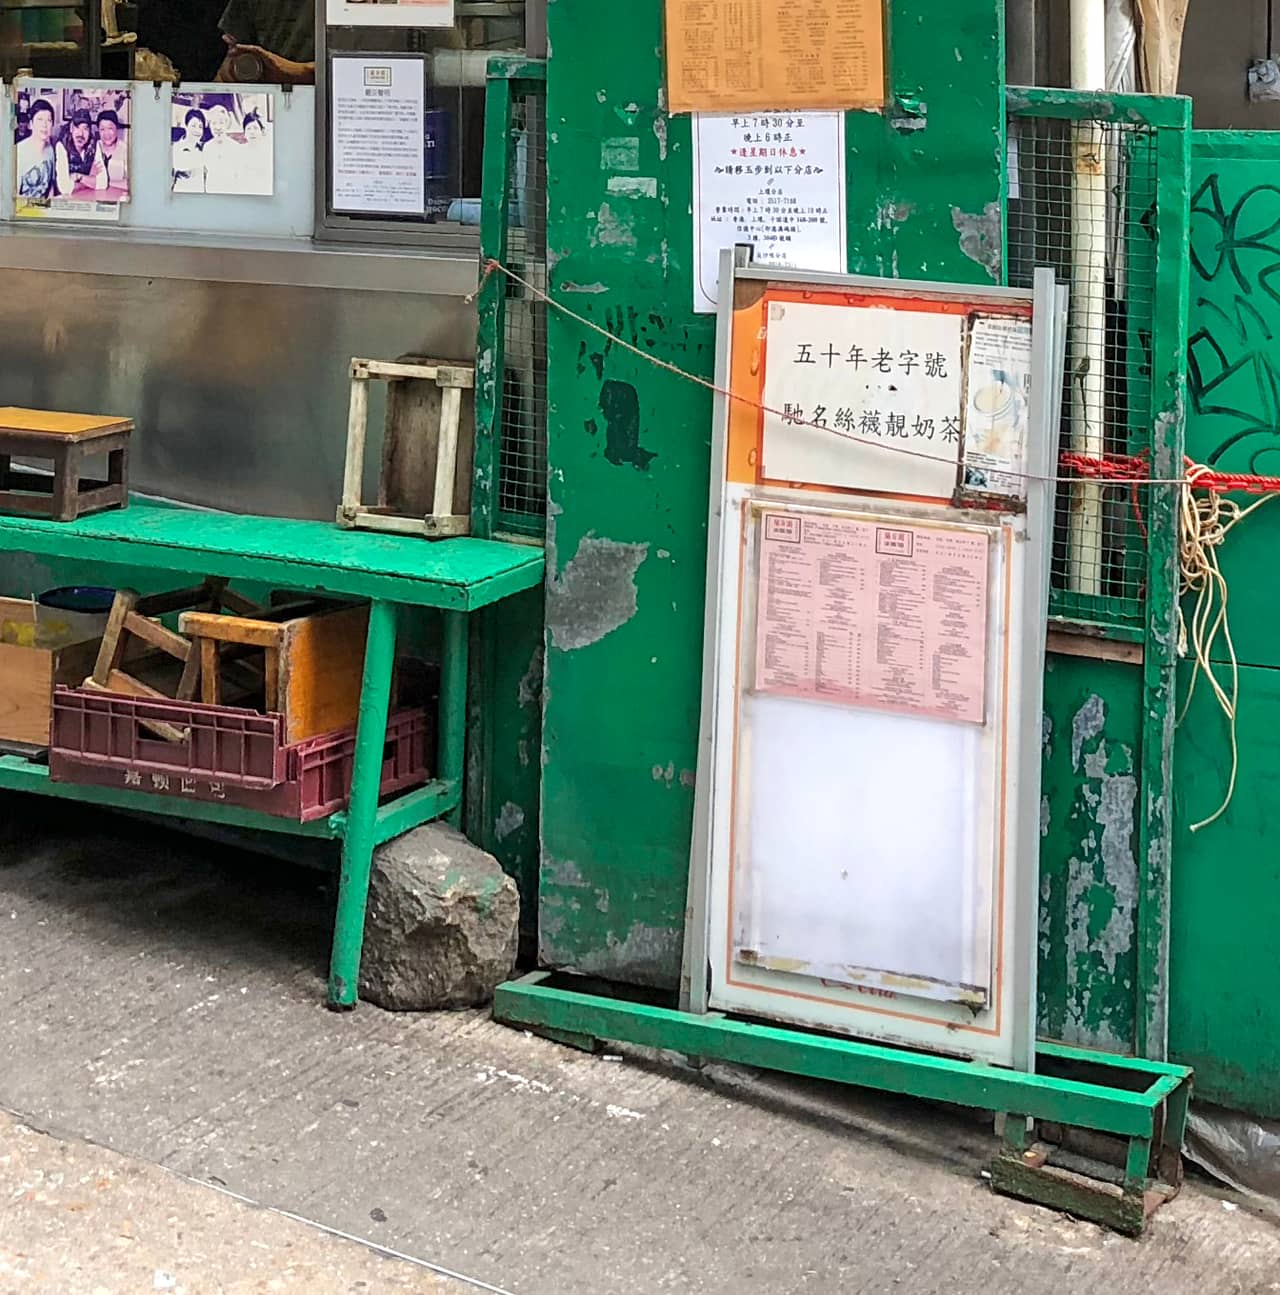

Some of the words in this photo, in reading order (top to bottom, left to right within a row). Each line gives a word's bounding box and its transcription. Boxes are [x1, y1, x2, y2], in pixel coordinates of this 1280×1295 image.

[792, 342, 949, 379] 五十年老字號
[780, 403, 961, 444] 馳名絲襪靚奶茶
